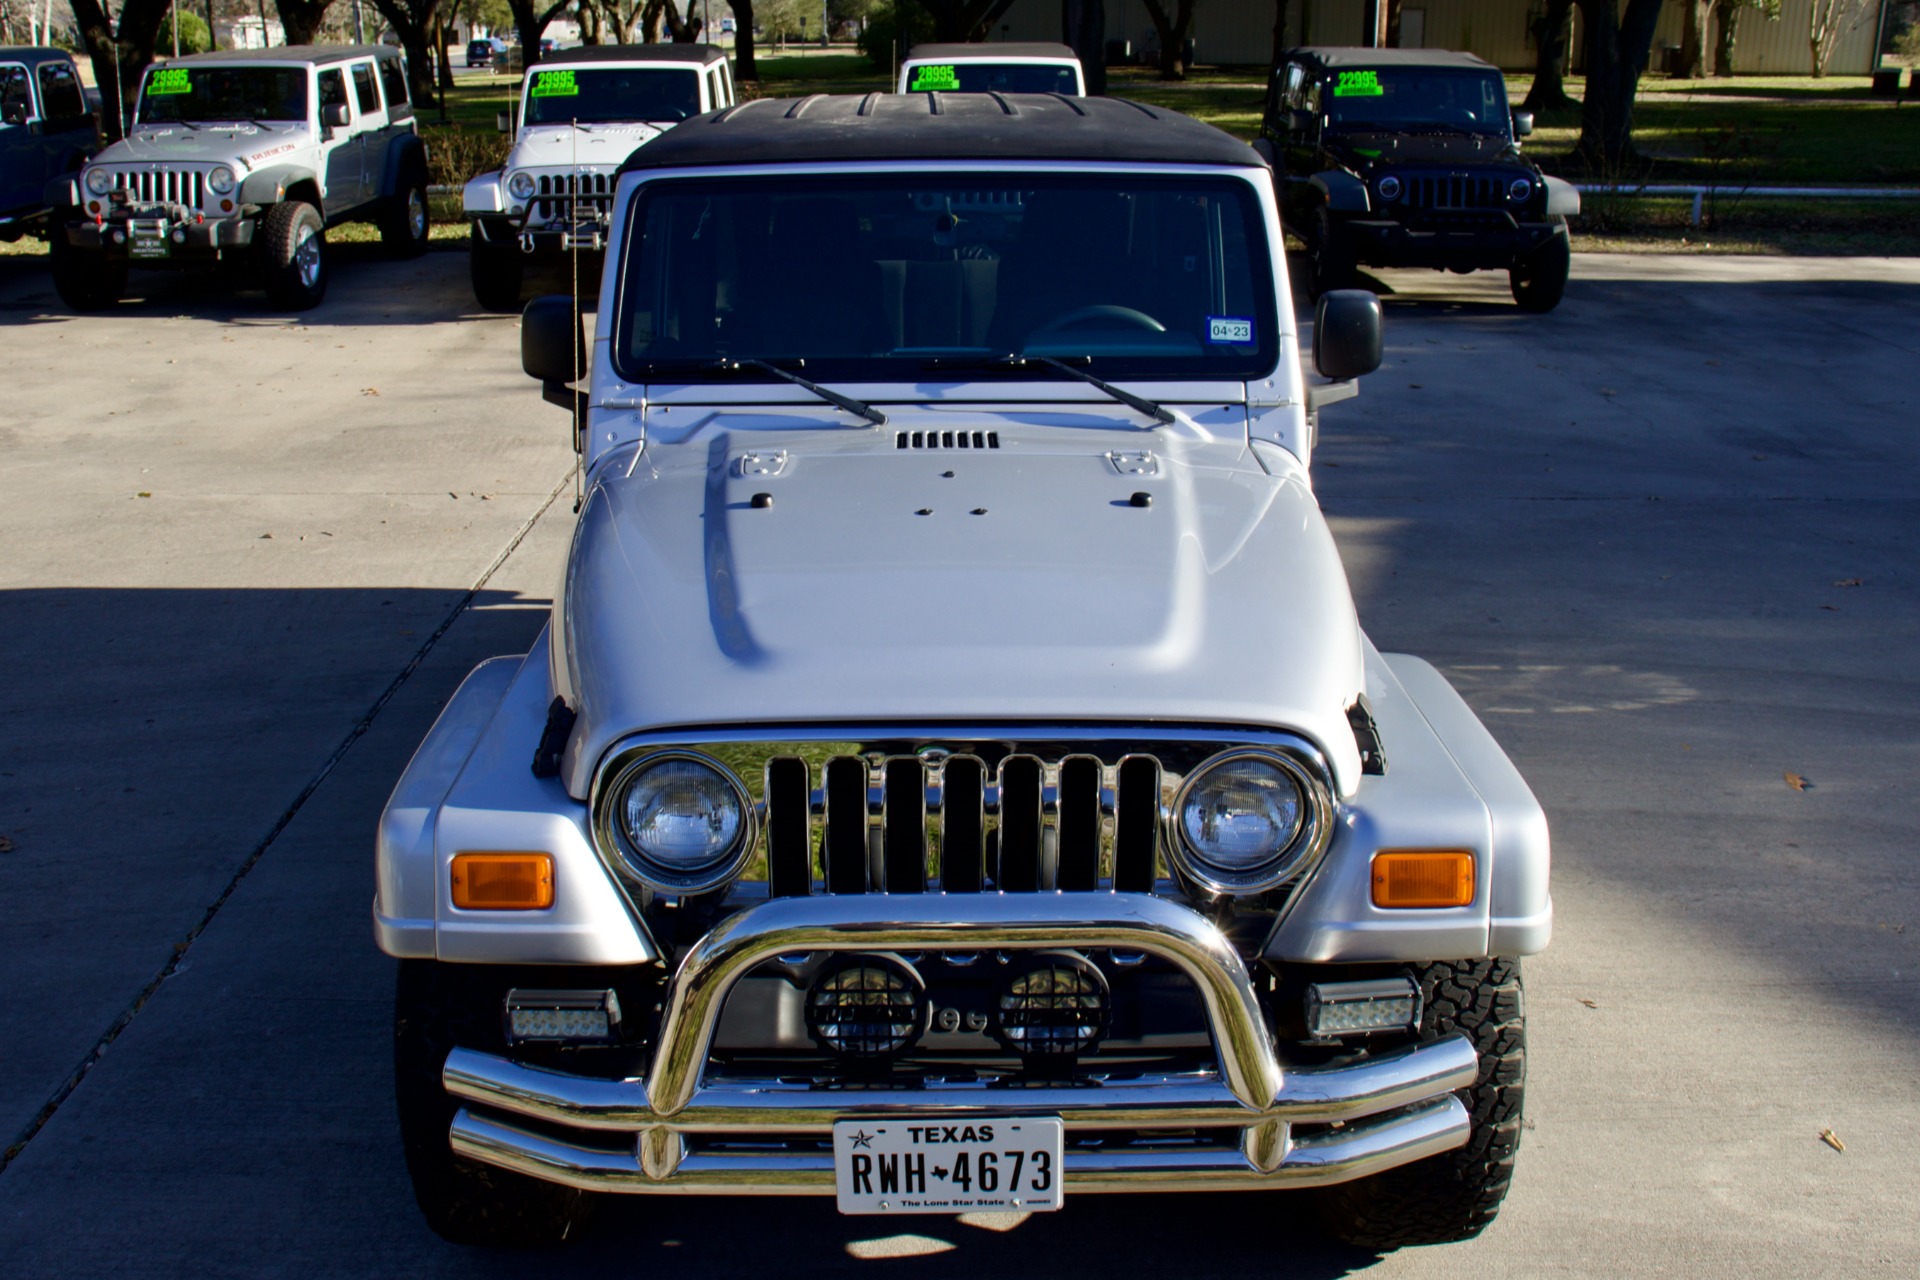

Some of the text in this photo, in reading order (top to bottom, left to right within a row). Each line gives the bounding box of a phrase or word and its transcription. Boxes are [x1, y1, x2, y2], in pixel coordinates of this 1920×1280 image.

[152, 69, 189, 87] 29995
[538, 71, 575, 88] 29995
[918, 65, 954, 81] 28995
[1339, 71, 1377, 88] 22995
[251, 143, 295, 161] RUBICON
[923, 999, 988, 1031] Jee
[907, 1125, 994, 1144] TEXAS
